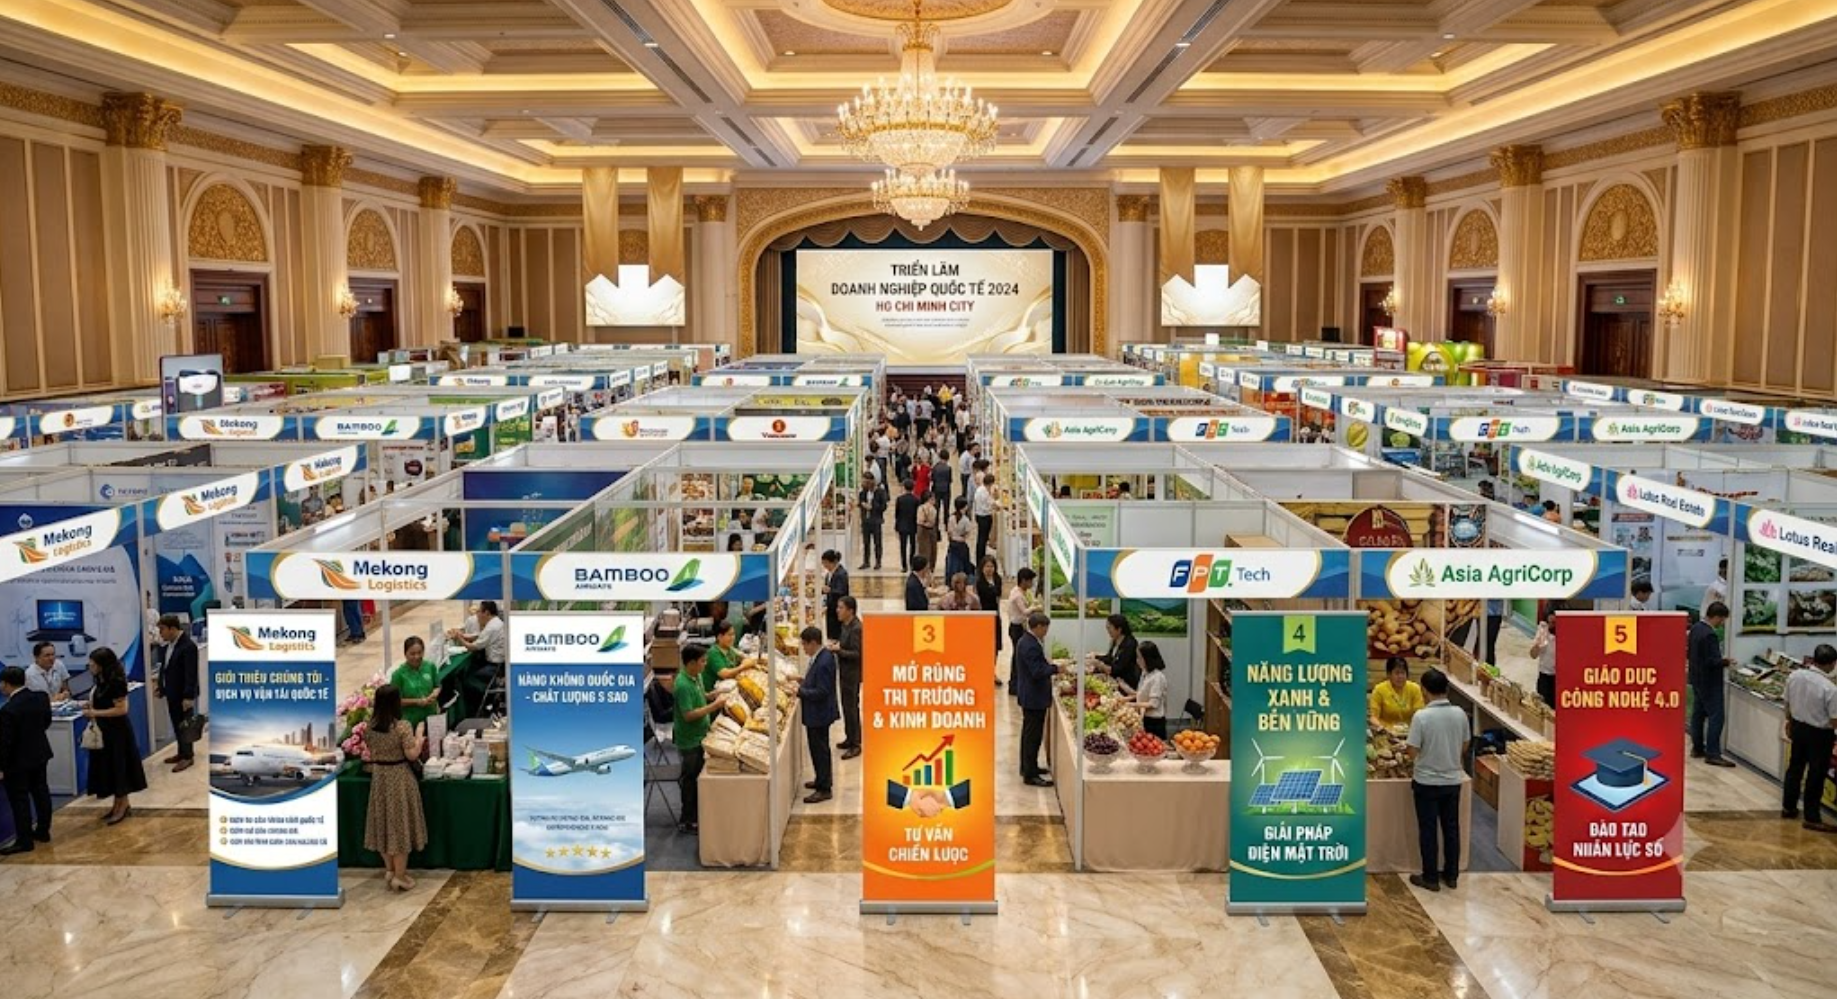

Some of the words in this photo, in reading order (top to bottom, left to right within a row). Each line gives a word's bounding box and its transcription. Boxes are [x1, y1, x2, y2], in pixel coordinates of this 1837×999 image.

[831, 282, 876, 296] DOANH
[988, 282, 1020, 296] 2024
[917, 300, 947, 312] MINH
[949, 300, 975, 312] CITY
[44, 525, 92, 546] Mekong
[1780, 526, 1810, 547] Lotus
[354, 560, 428, 580] Mekong
[574, 568, 670, 582] BAMBOO
[1237, 566, 1270, 581] Tech
[1441, 564, 1482, 582] Asia
[1487, 564, 1573, 586] AgriCorp
[368, 579, 427, 592] Logistics
[258, 626, 316, 641] Mekong
[922, 624, 936, 644] 3
[1292, 624, 1306, 643] 4
[1614, 624, 1628, 644] 5
[1247, 660, 1293, 683] NĂNG
[1268, 689, 1314, 706] XANH
[1318, 689, 1330, 706] &
[1654, 691, 1680, 708] 4.0
[873, 711, 884, 728] &
[890, 711, 926, 728] KINH
[931, 711, 986, 728] DOANH
[1296, 822, 1334, 840] PHÁP
